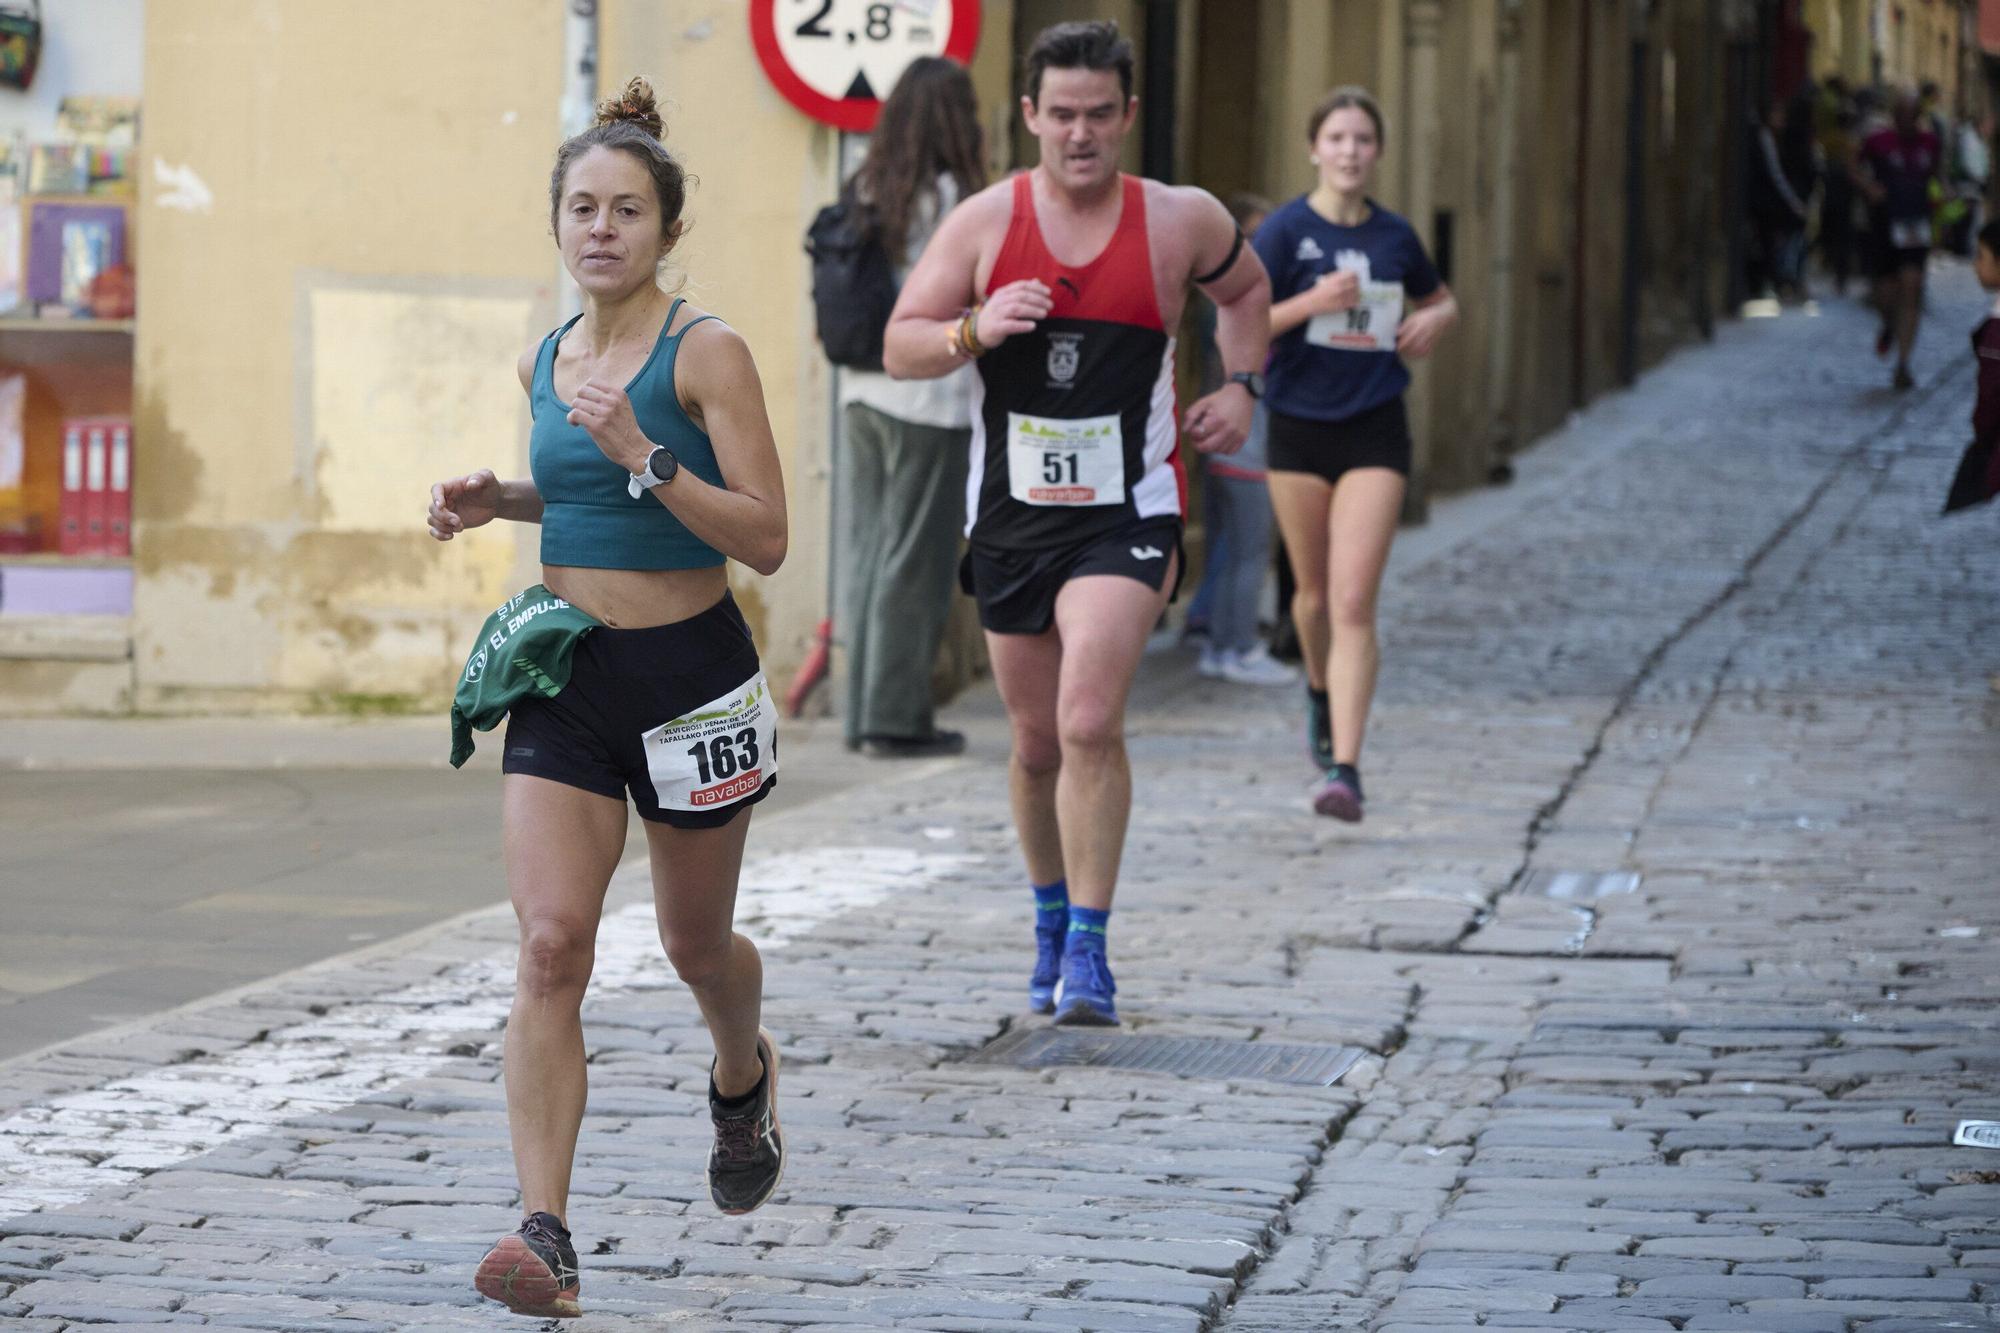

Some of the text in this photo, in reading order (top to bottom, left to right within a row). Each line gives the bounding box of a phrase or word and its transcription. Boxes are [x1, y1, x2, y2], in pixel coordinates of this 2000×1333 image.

[1043, 452, 1078, 484] 51
[490, 629, 508, 651] EL
[507, 598, 570, 636] EMPUJE
[681, 723, 702, 734] CROSS
[729, 716, 740, 724] DE
[740, 703, 761, 720] TAFALLA
[729, 699, 742, 710] 2025
[659, 731, 702, 745] TAFALLAKO
[727, 719, 748, 731] HERRI
[687, 727, 760, 785] 163
[694, 772, 762, 804] navarbar
